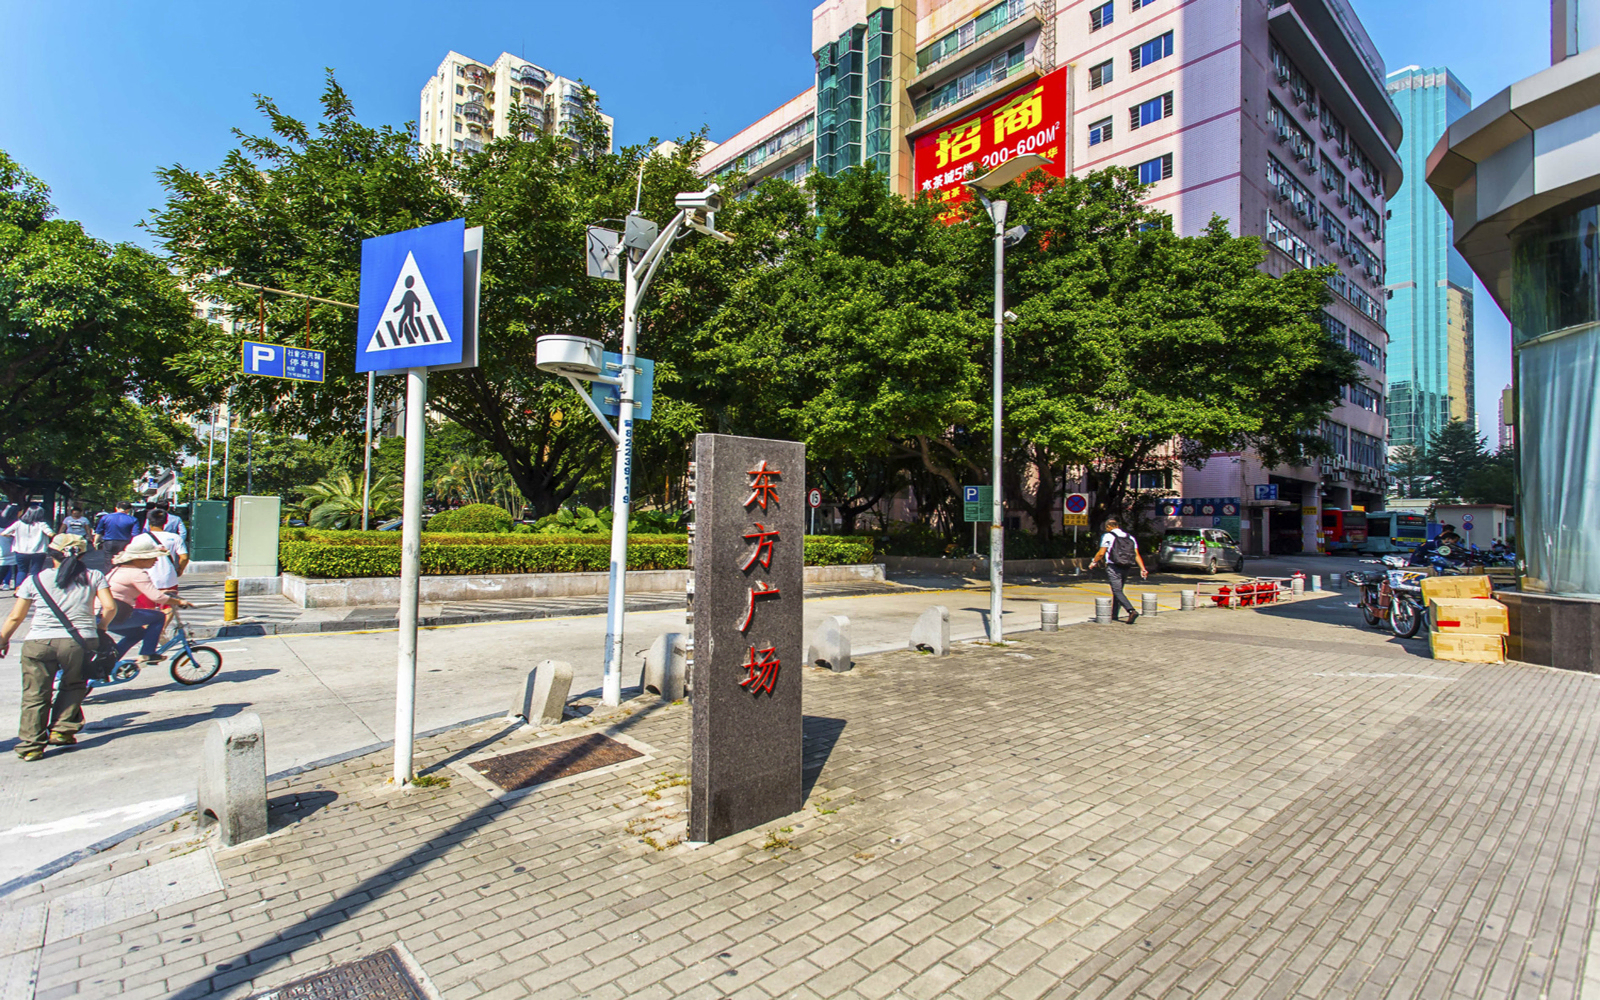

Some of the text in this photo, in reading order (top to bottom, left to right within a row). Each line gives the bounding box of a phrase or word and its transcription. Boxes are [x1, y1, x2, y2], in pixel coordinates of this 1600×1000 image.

[935, 86, 1044, 169] 招商
[252, 345, 275, 372] P
[811, 492, 819, 503] 15
[966, 488, 977, 500] P
[1213, 517, 1220, 525] P
[737, 460, 781, 694] 东方广场
